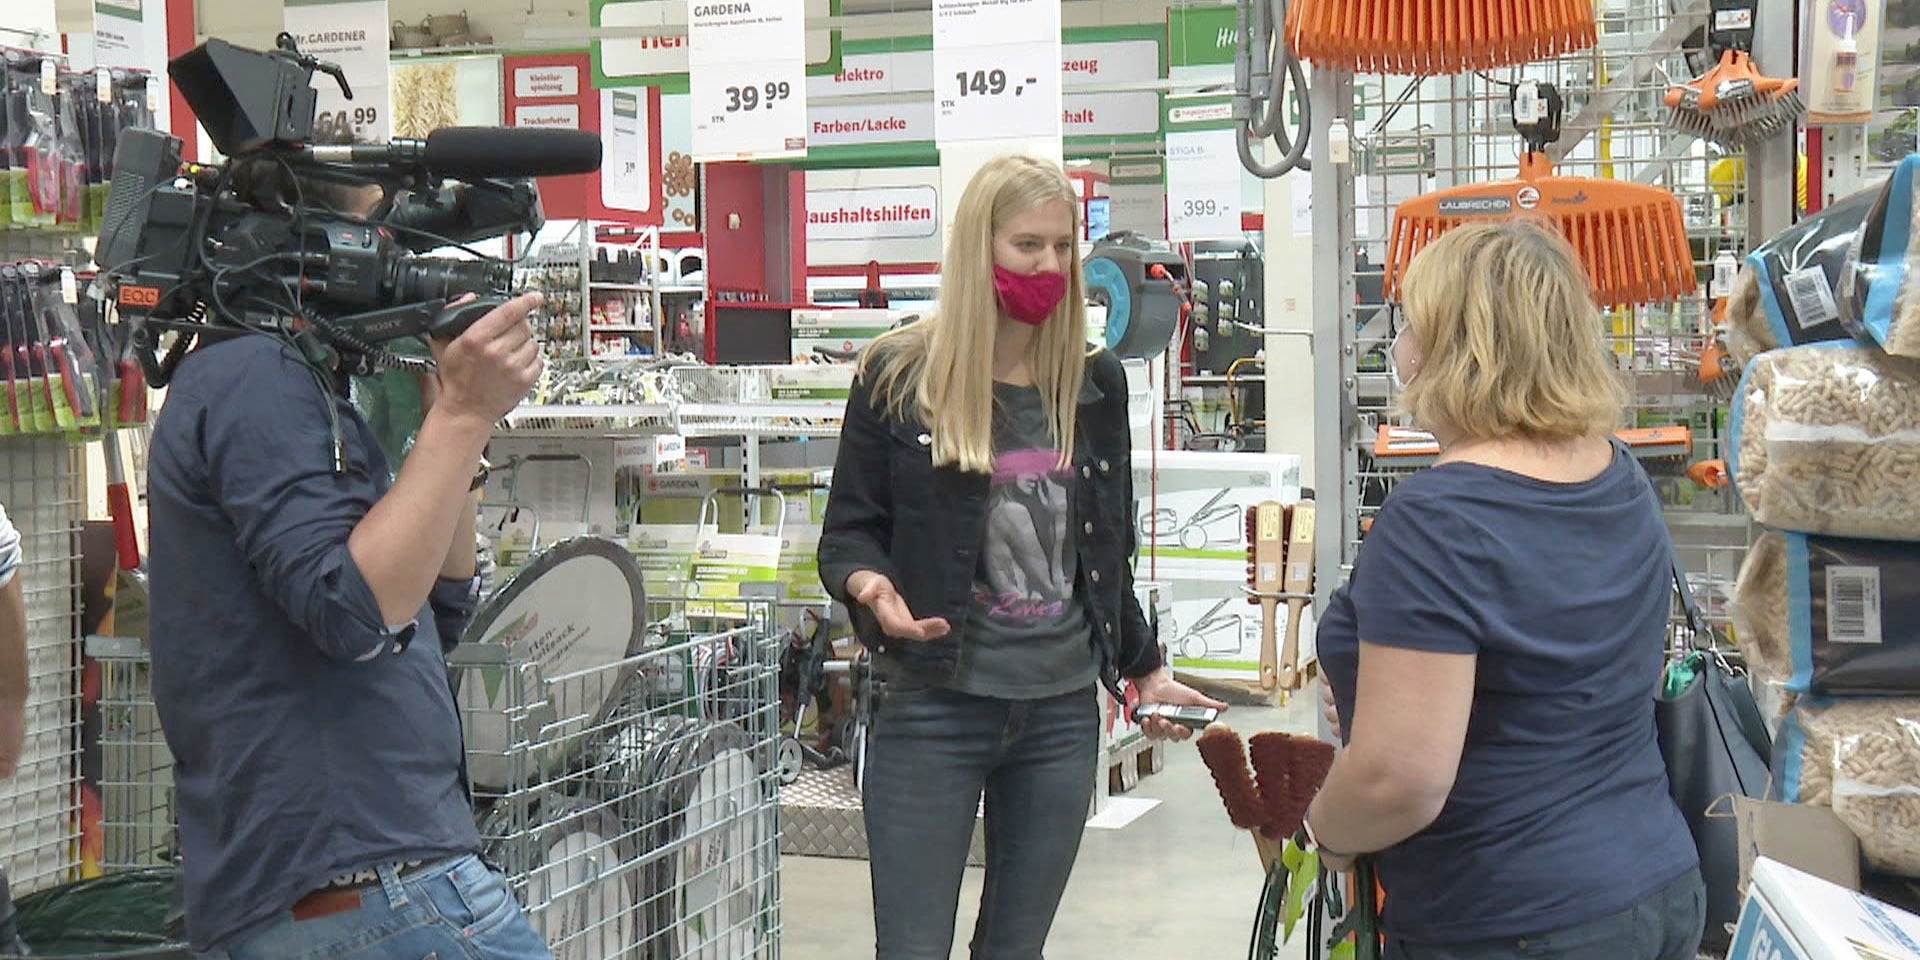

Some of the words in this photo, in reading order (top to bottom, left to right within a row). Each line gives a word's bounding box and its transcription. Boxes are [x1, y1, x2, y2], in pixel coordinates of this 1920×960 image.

[694, 3, 751, 17] GARDENA
[1061, 58, 1098, 74] zeug
[813, 116, 907, 134] Farben/Lacke
[1439, 199, 1511, 210] LAUBRECHEN
